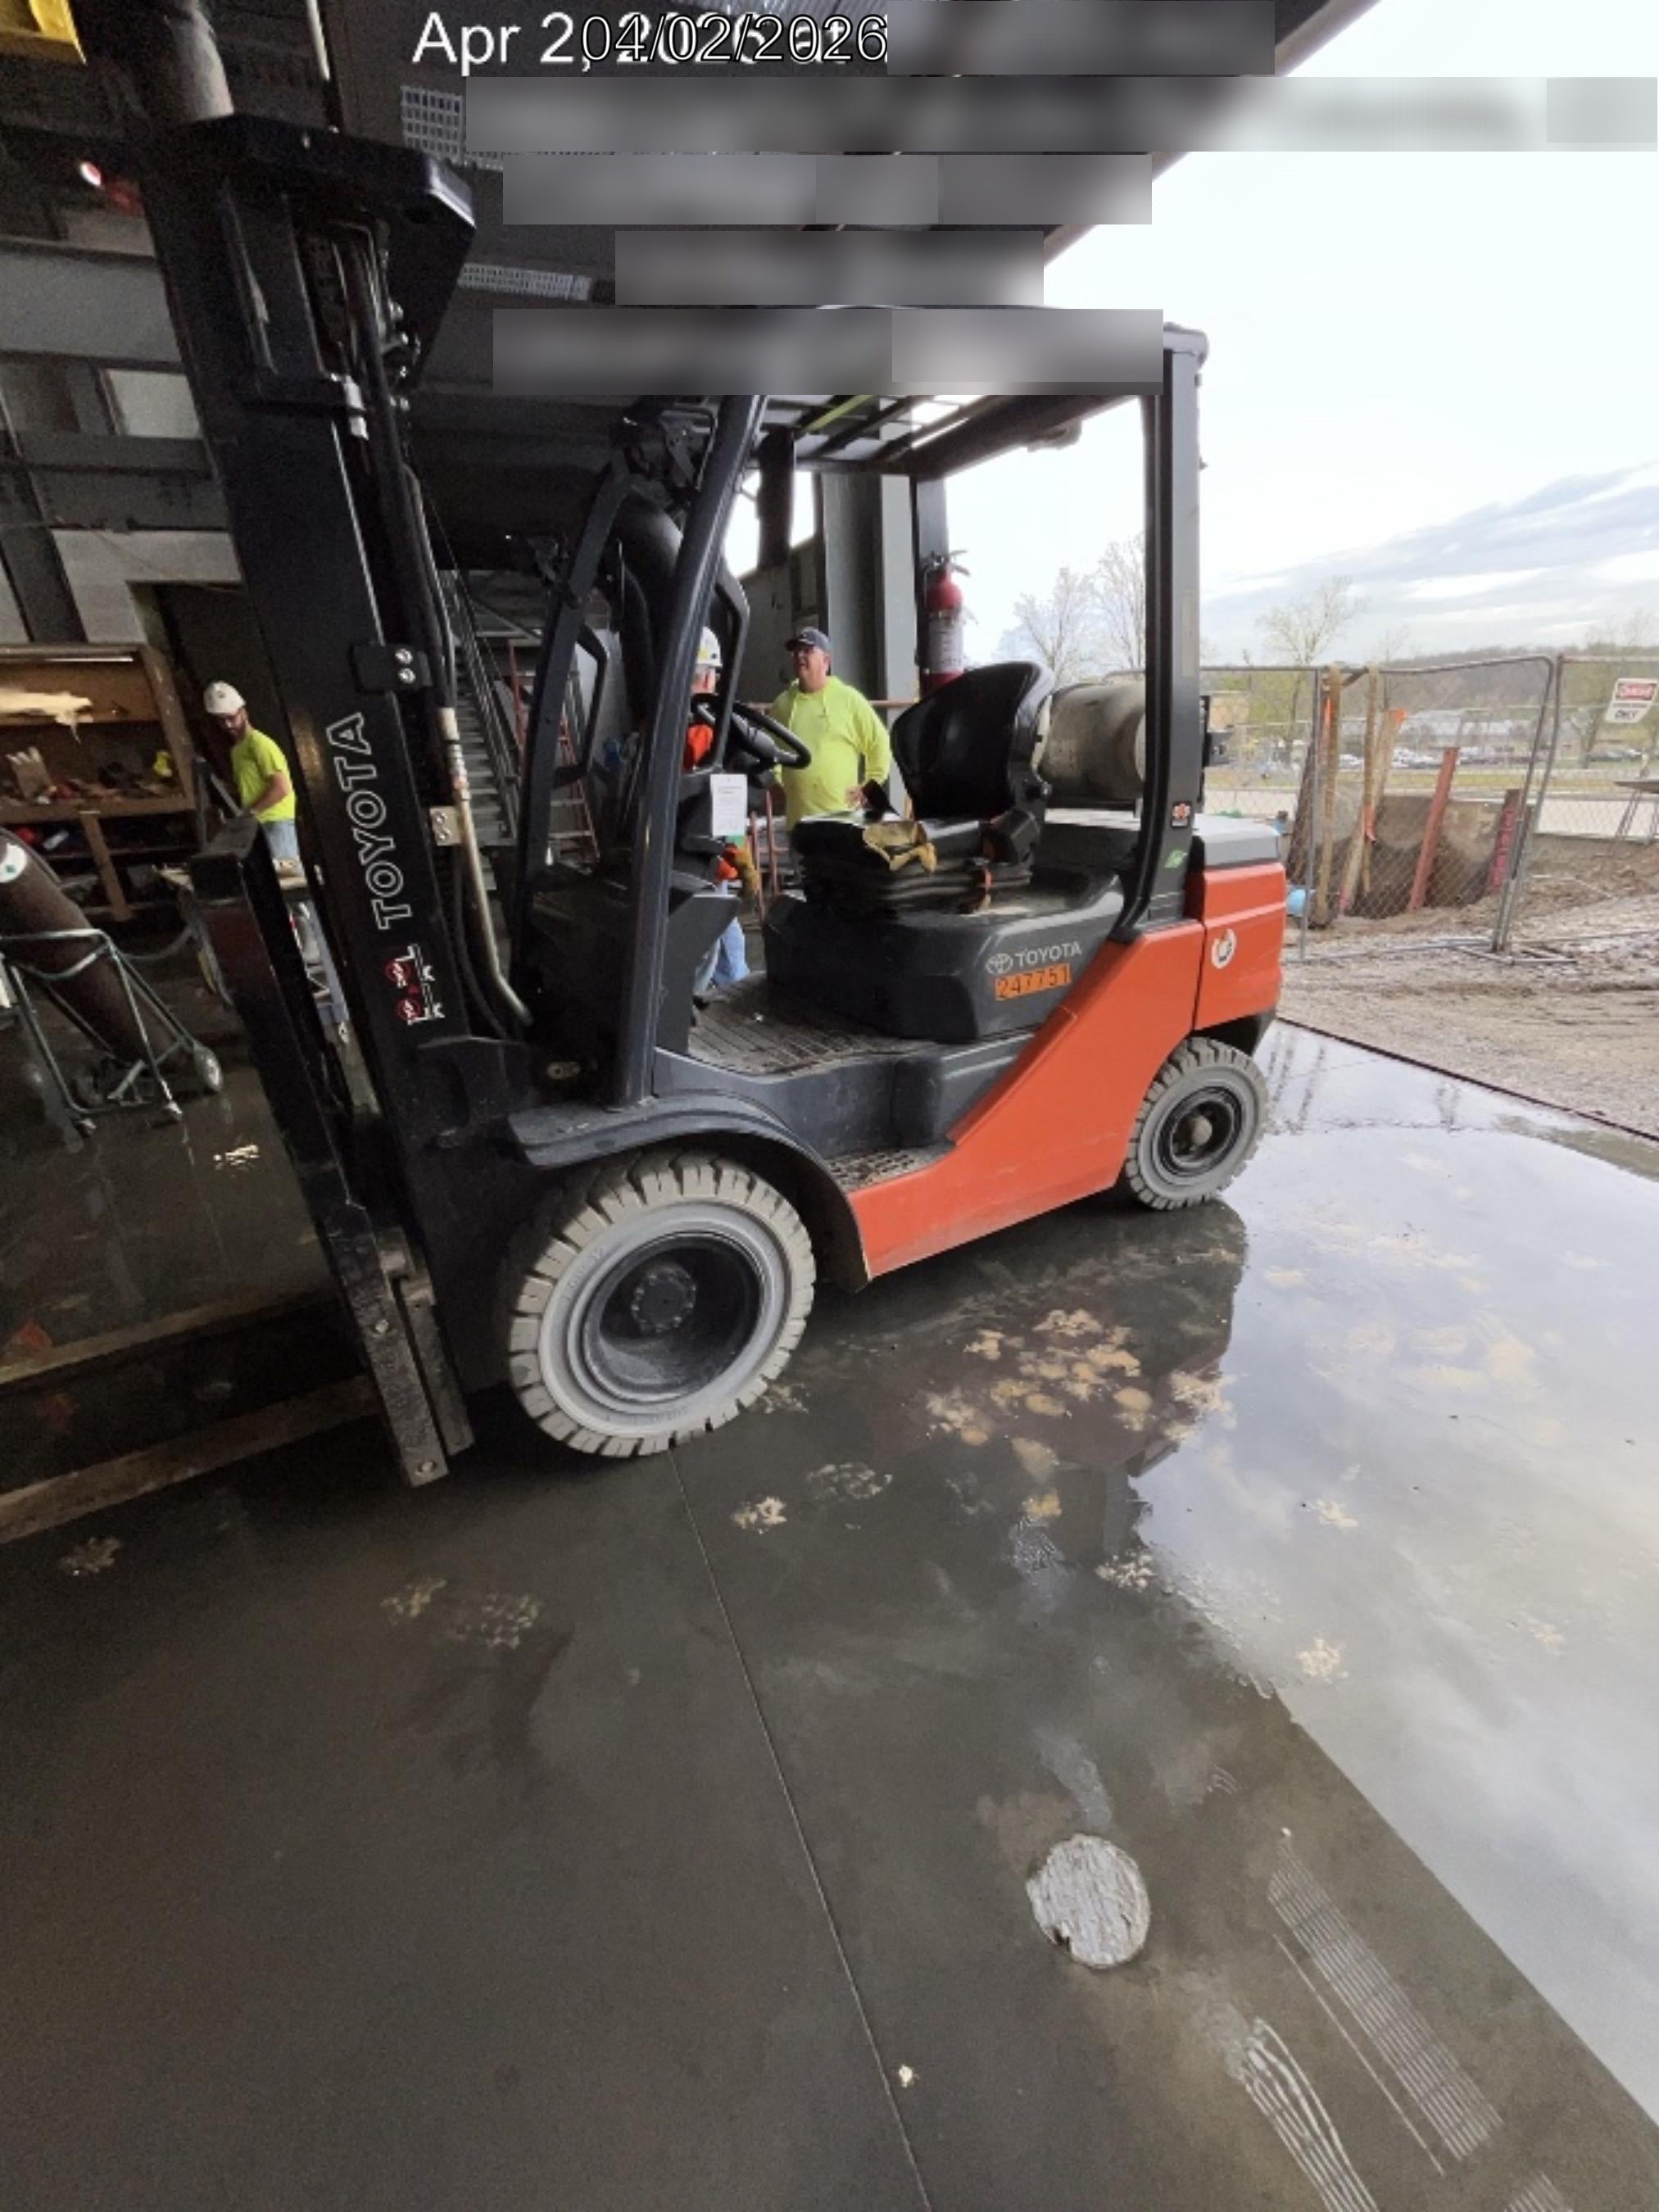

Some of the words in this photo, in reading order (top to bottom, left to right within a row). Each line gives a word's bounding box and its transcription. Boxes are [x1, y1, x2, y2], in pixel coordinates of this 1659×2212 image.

[327, 712, 413, 931] TOYOTA
[1014, 941, 1082, 969] TOYOTA
[996, 965, 1068, 999] 247751
